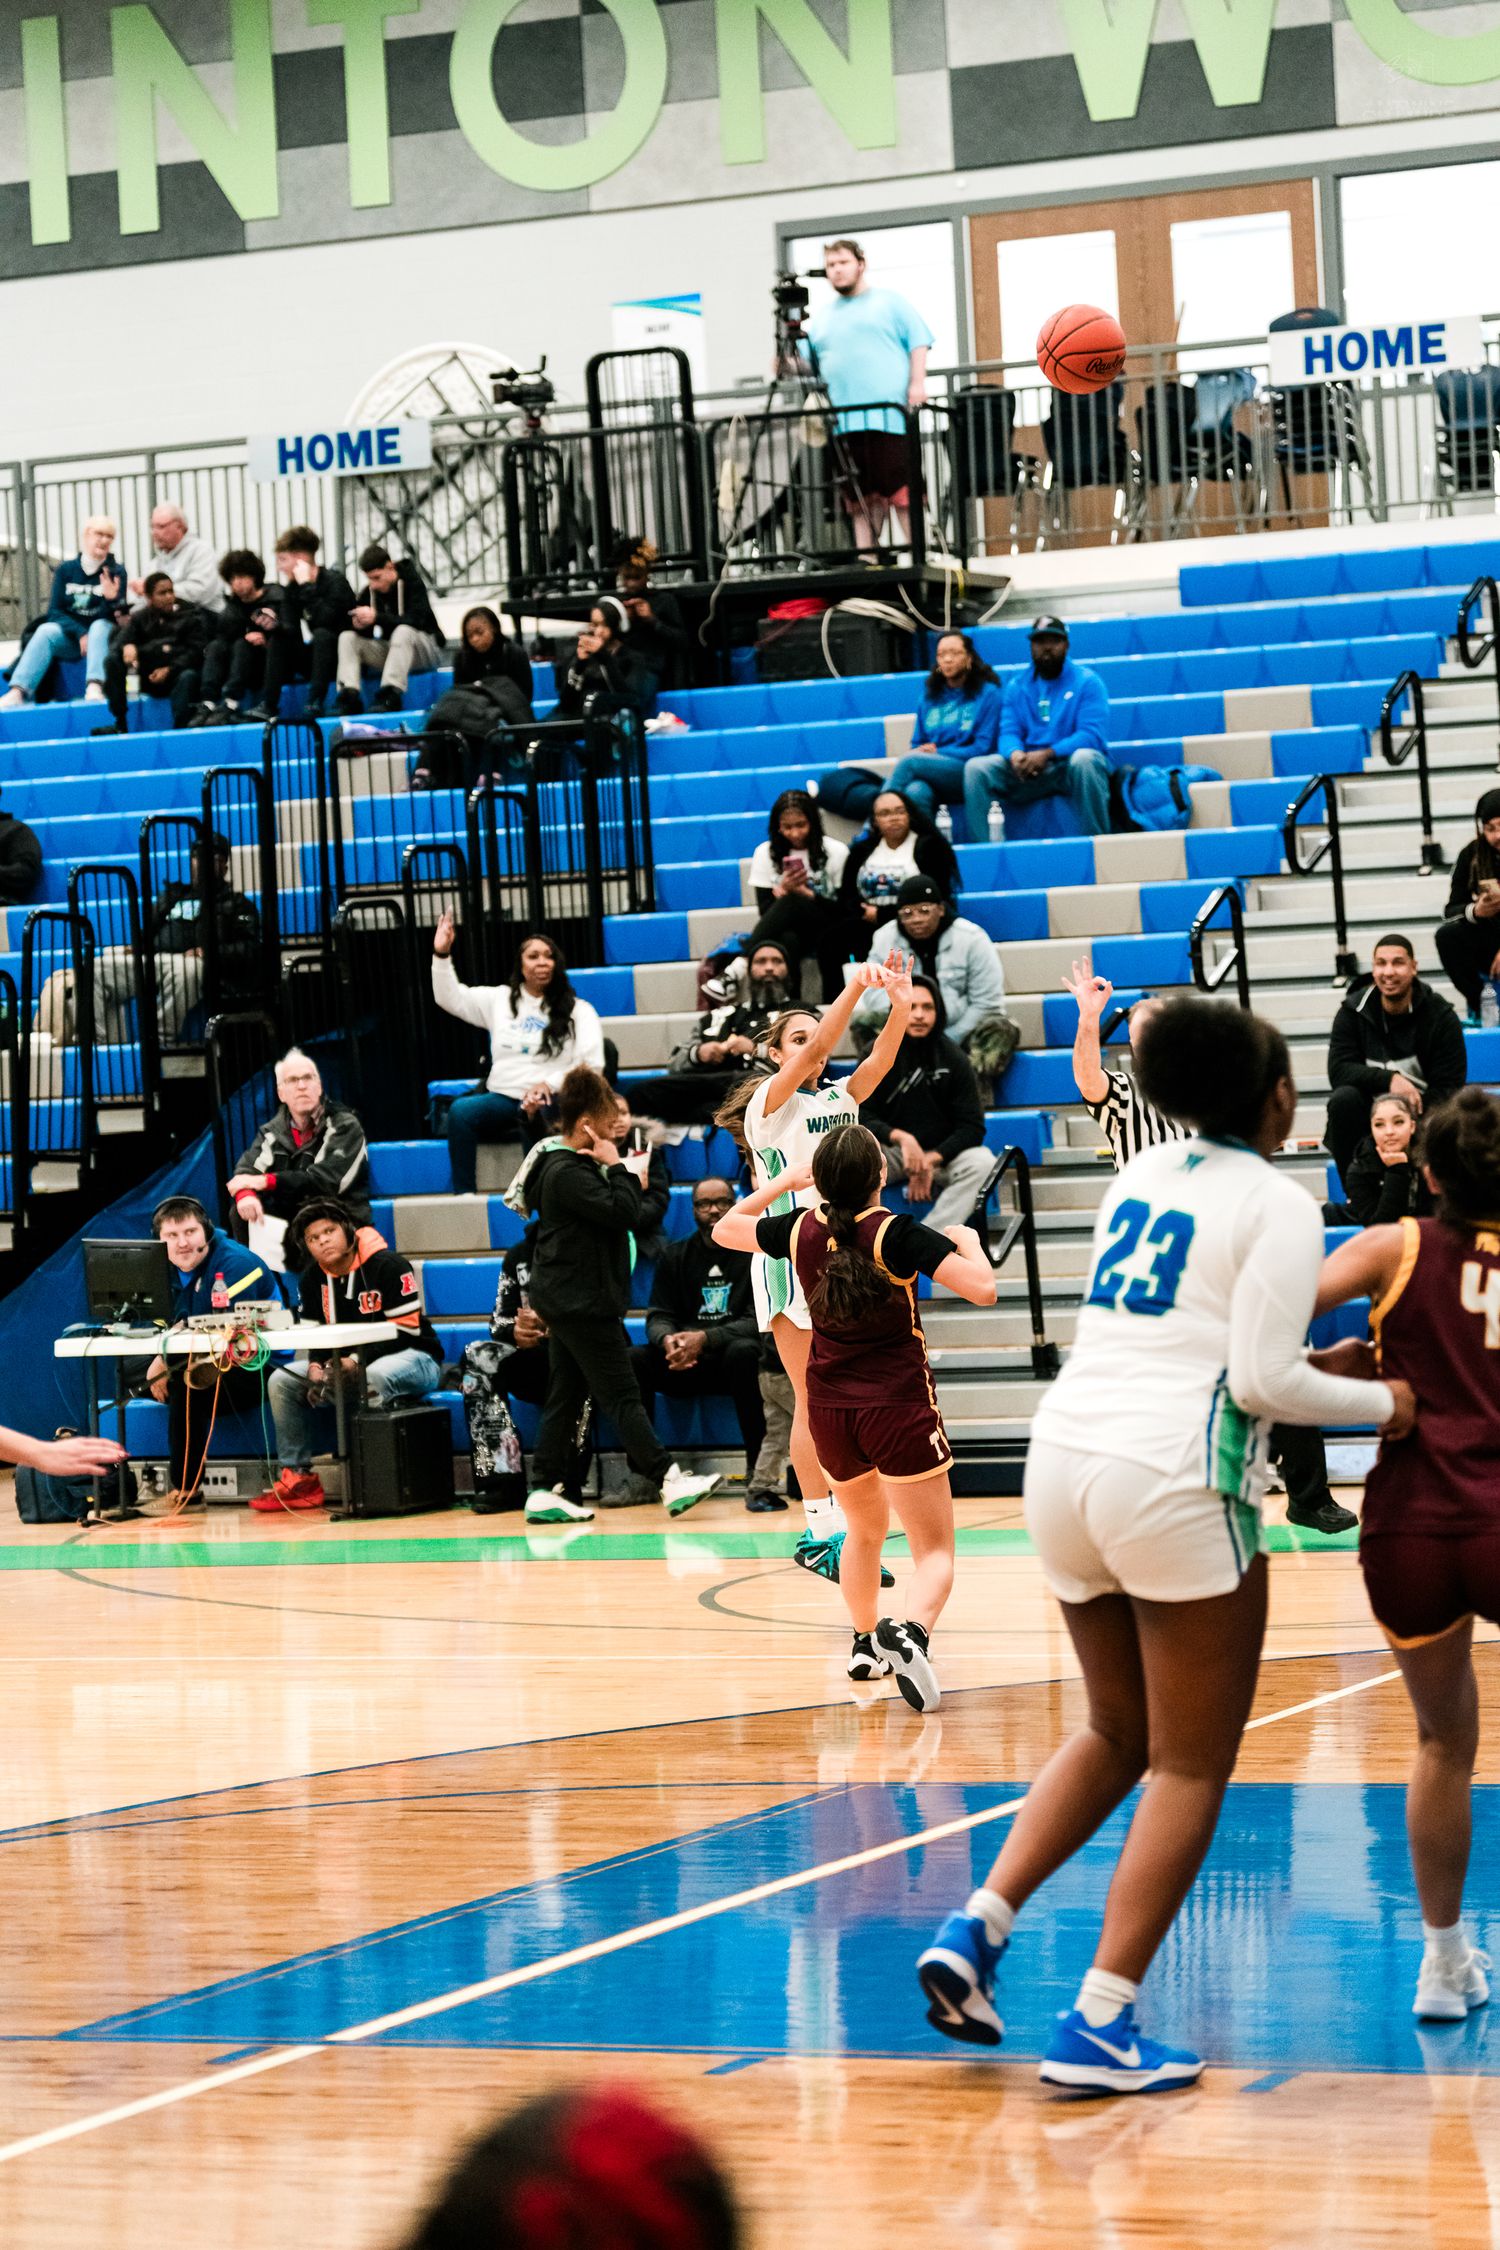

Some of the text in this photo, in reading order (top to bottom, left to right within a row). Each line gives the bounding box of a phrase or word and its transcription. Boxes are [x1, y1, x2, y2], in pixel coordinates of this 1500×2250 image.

[20, 0, 897, 246] INTON
[1303, 323, 1447, 376] HOME
[277, 426, 402, 475] HOME
[1087, 1198, 1195, 1317] 23
